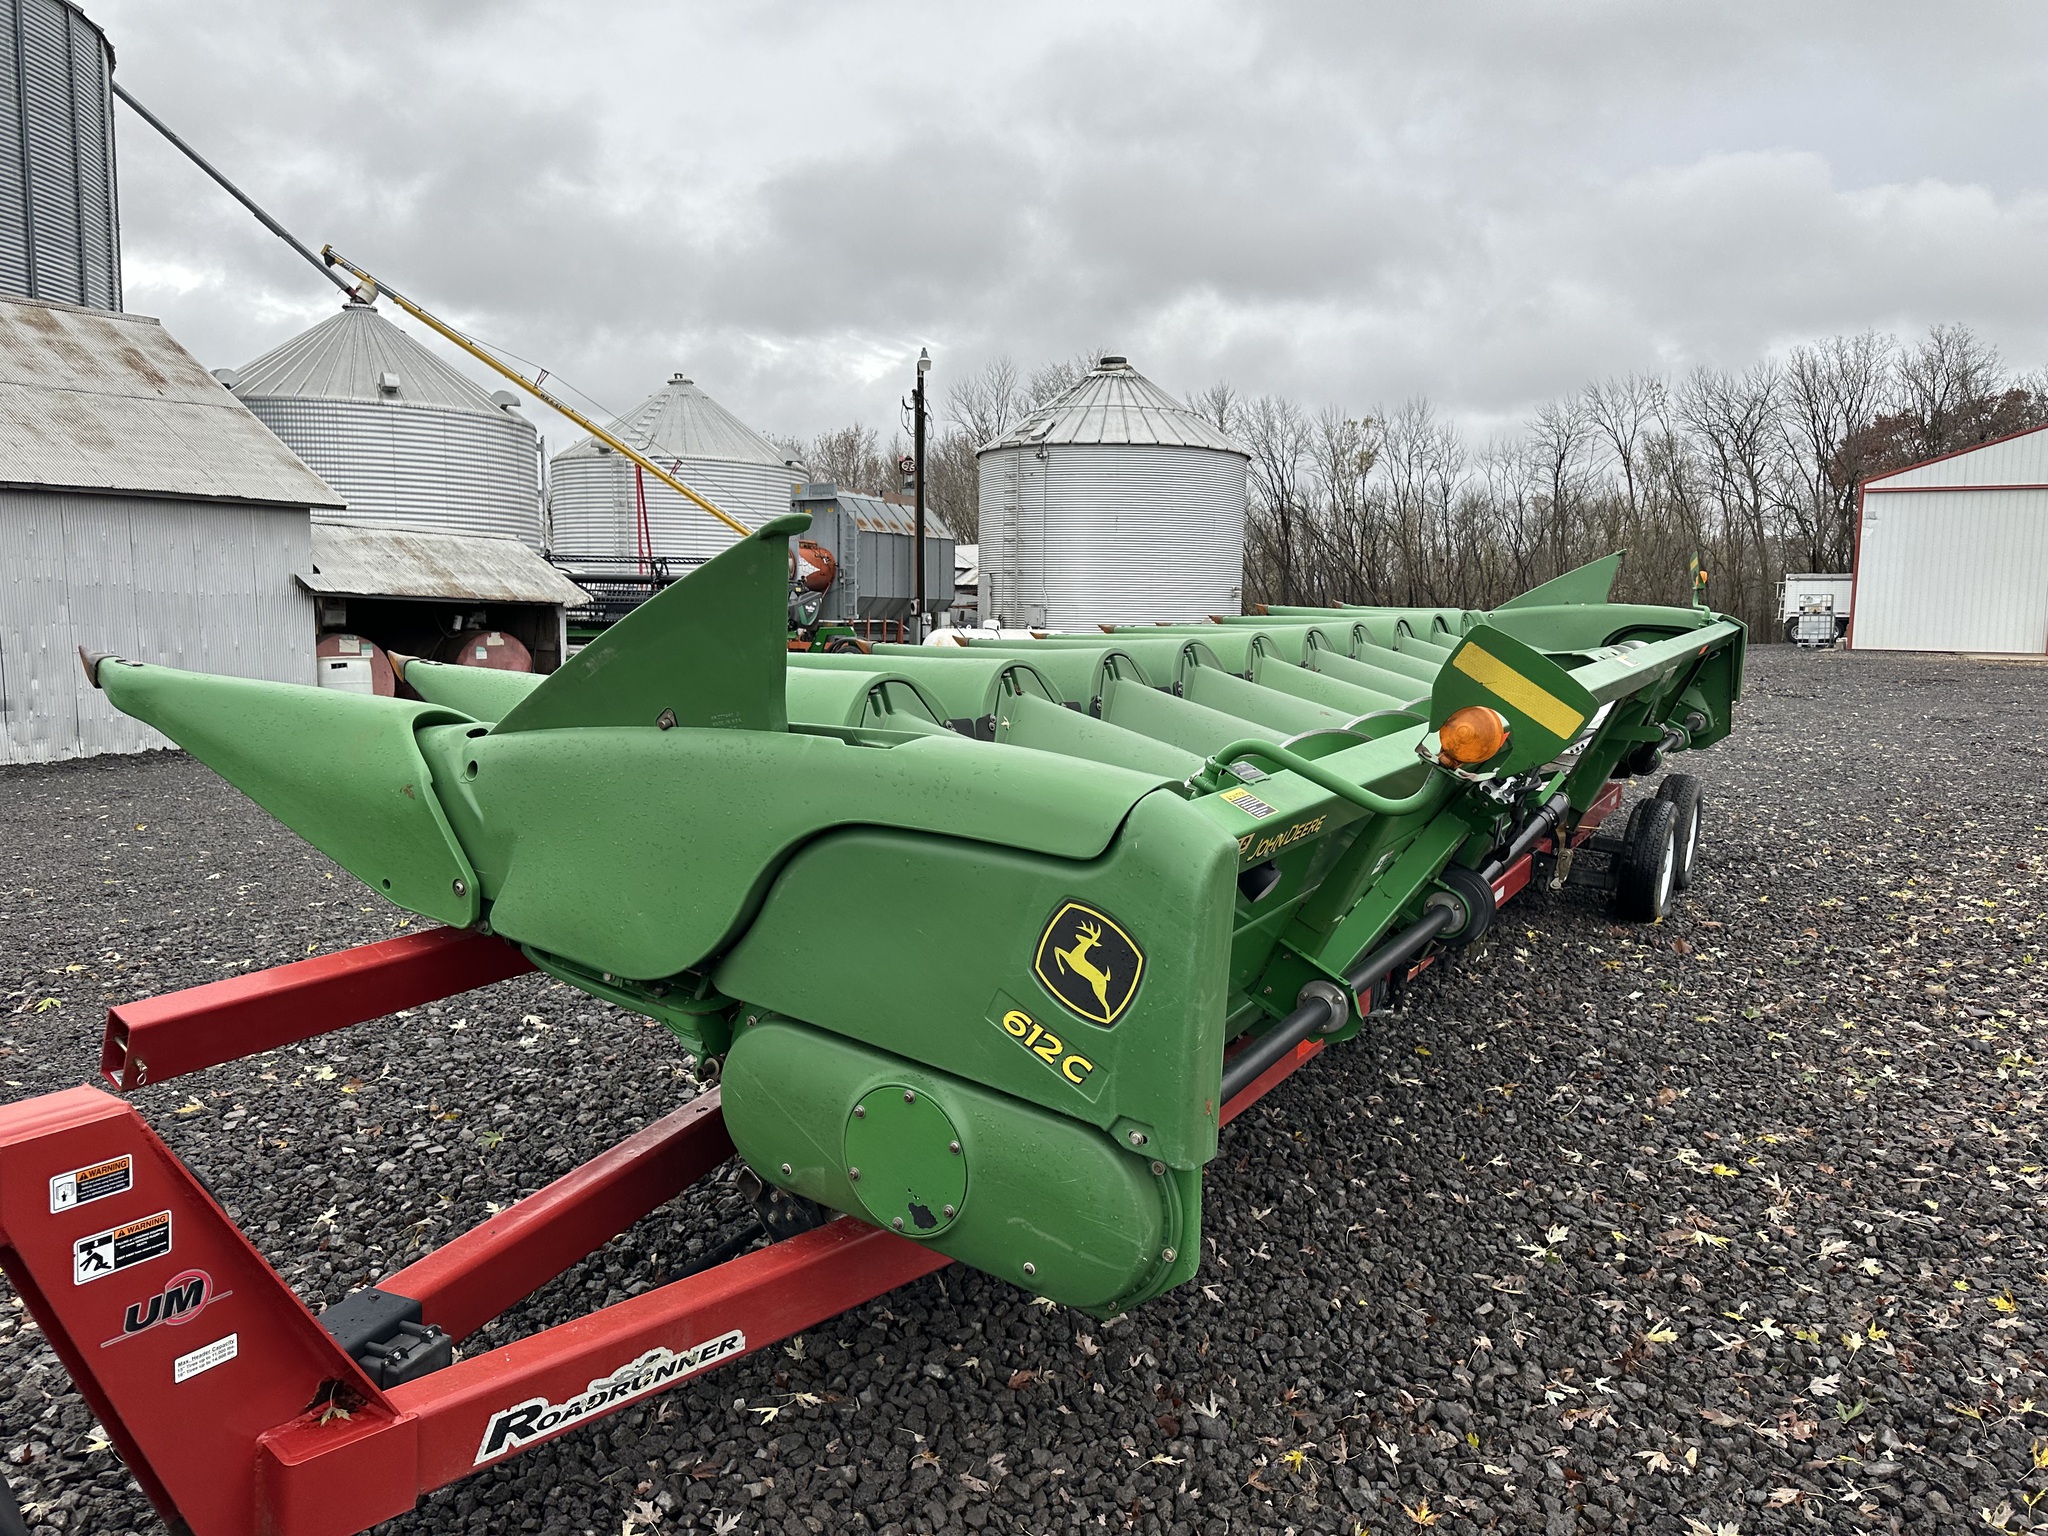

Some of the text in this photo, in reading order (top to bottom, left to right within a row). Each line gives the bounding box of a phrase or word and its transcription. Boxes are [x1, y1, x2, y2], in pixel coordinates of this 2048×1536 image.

[1247, 814, 1328, 861] JOHN DEERE
[1001, 1009, 1094, 1086] 612C
[88, 1160, 127, 1178] WARNING
[127, 1215, 166, 1234] WARNING
[124, 1279, 205, 1334] UM
[192, 1350, 211, 1361] Header
[212, 1339, 235, 1352] Capacity
[484, 1335, 738, 1455] ROADRUNNER
